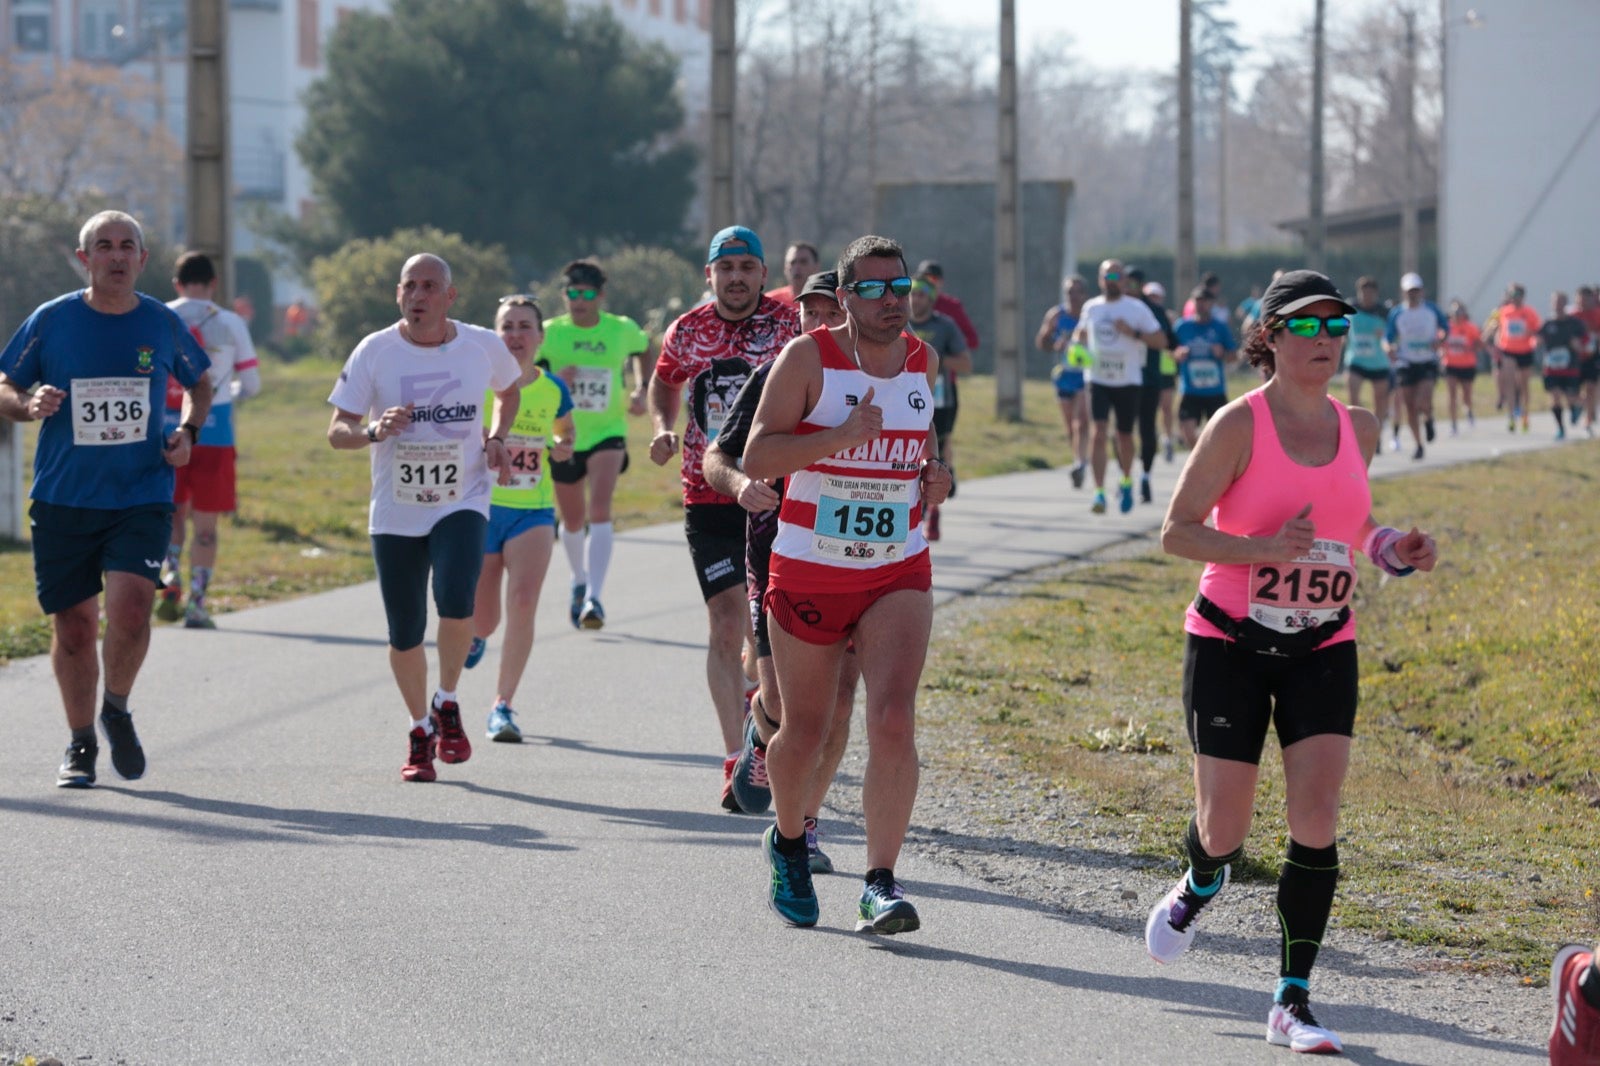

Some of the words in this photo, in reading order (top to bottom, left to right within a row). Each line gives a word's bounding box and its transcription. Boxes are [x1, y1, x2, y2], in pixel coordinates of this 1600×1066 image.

[82, 401, 143, 423] 3136
[400, 464, 457, 485] 3112
[844, 480, 859, 489] GRAN
[860, 482, 881, 491] PREMIO
[882, 483, 889, 491] DE
[834, 505, 895, 538] 158
[1256, 566, 1352, 603] 2150
